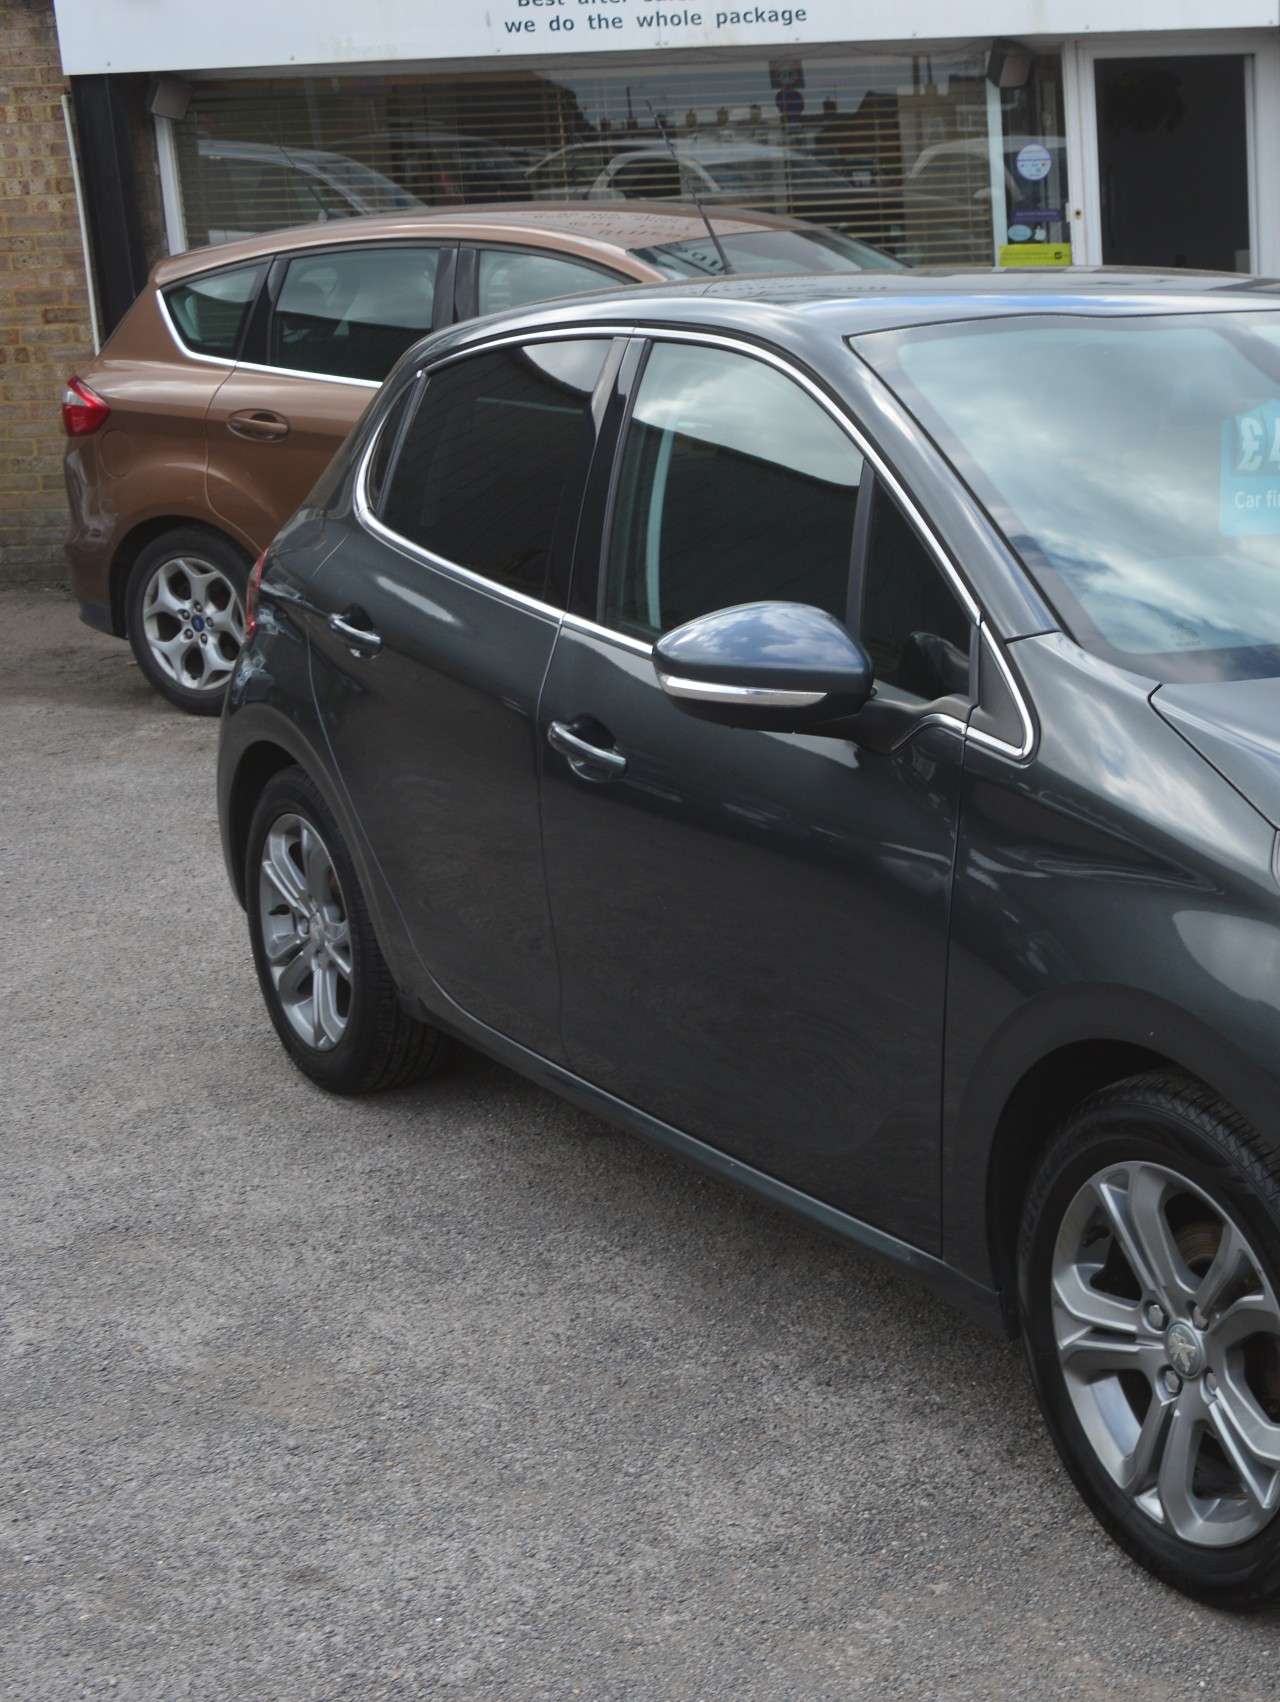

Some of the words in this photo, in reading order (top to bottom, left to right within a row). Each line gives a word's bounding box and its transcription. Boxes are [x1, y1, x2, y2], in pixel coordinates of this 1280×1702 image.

[504, 18, 537, 33] we
[549, 15, 575, 31] do
[588, 13, 624, 31] the
[636, 9, 703, 28] whole
[716, 7, 808, 29] package
[1234, 490, 1262, 509] Car
